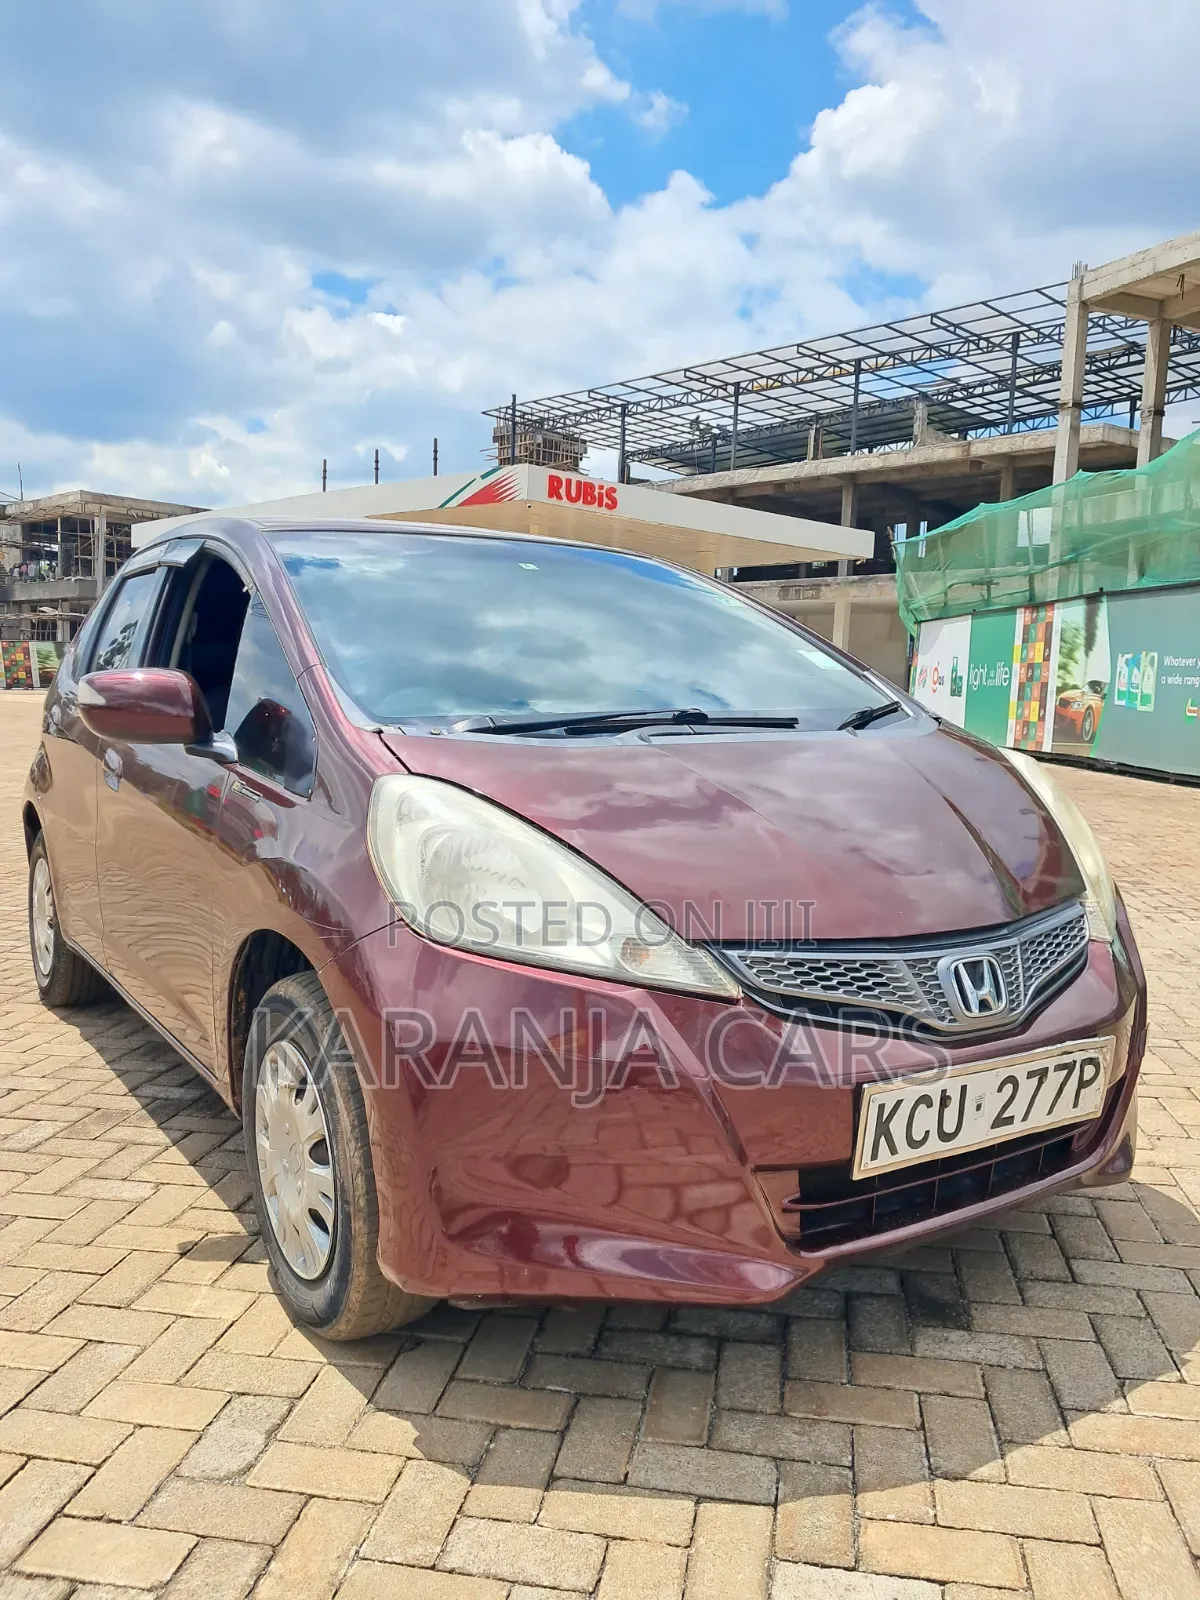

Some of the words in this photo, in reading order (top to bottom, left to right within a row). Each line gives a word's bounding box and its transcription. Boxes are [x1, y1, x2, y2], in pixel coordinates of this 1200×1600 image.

[1164, 656, 1196, 666] Whatever
[970, 663, 987, 690] light
[995, 661, 1010, 687] life
[1161, 676, 1165, 684] a
[1167, 673, 1182, 685] wide
[870, 1083, 968, 1162] KCU
[990, 1056, 1101, 1130] 277P
